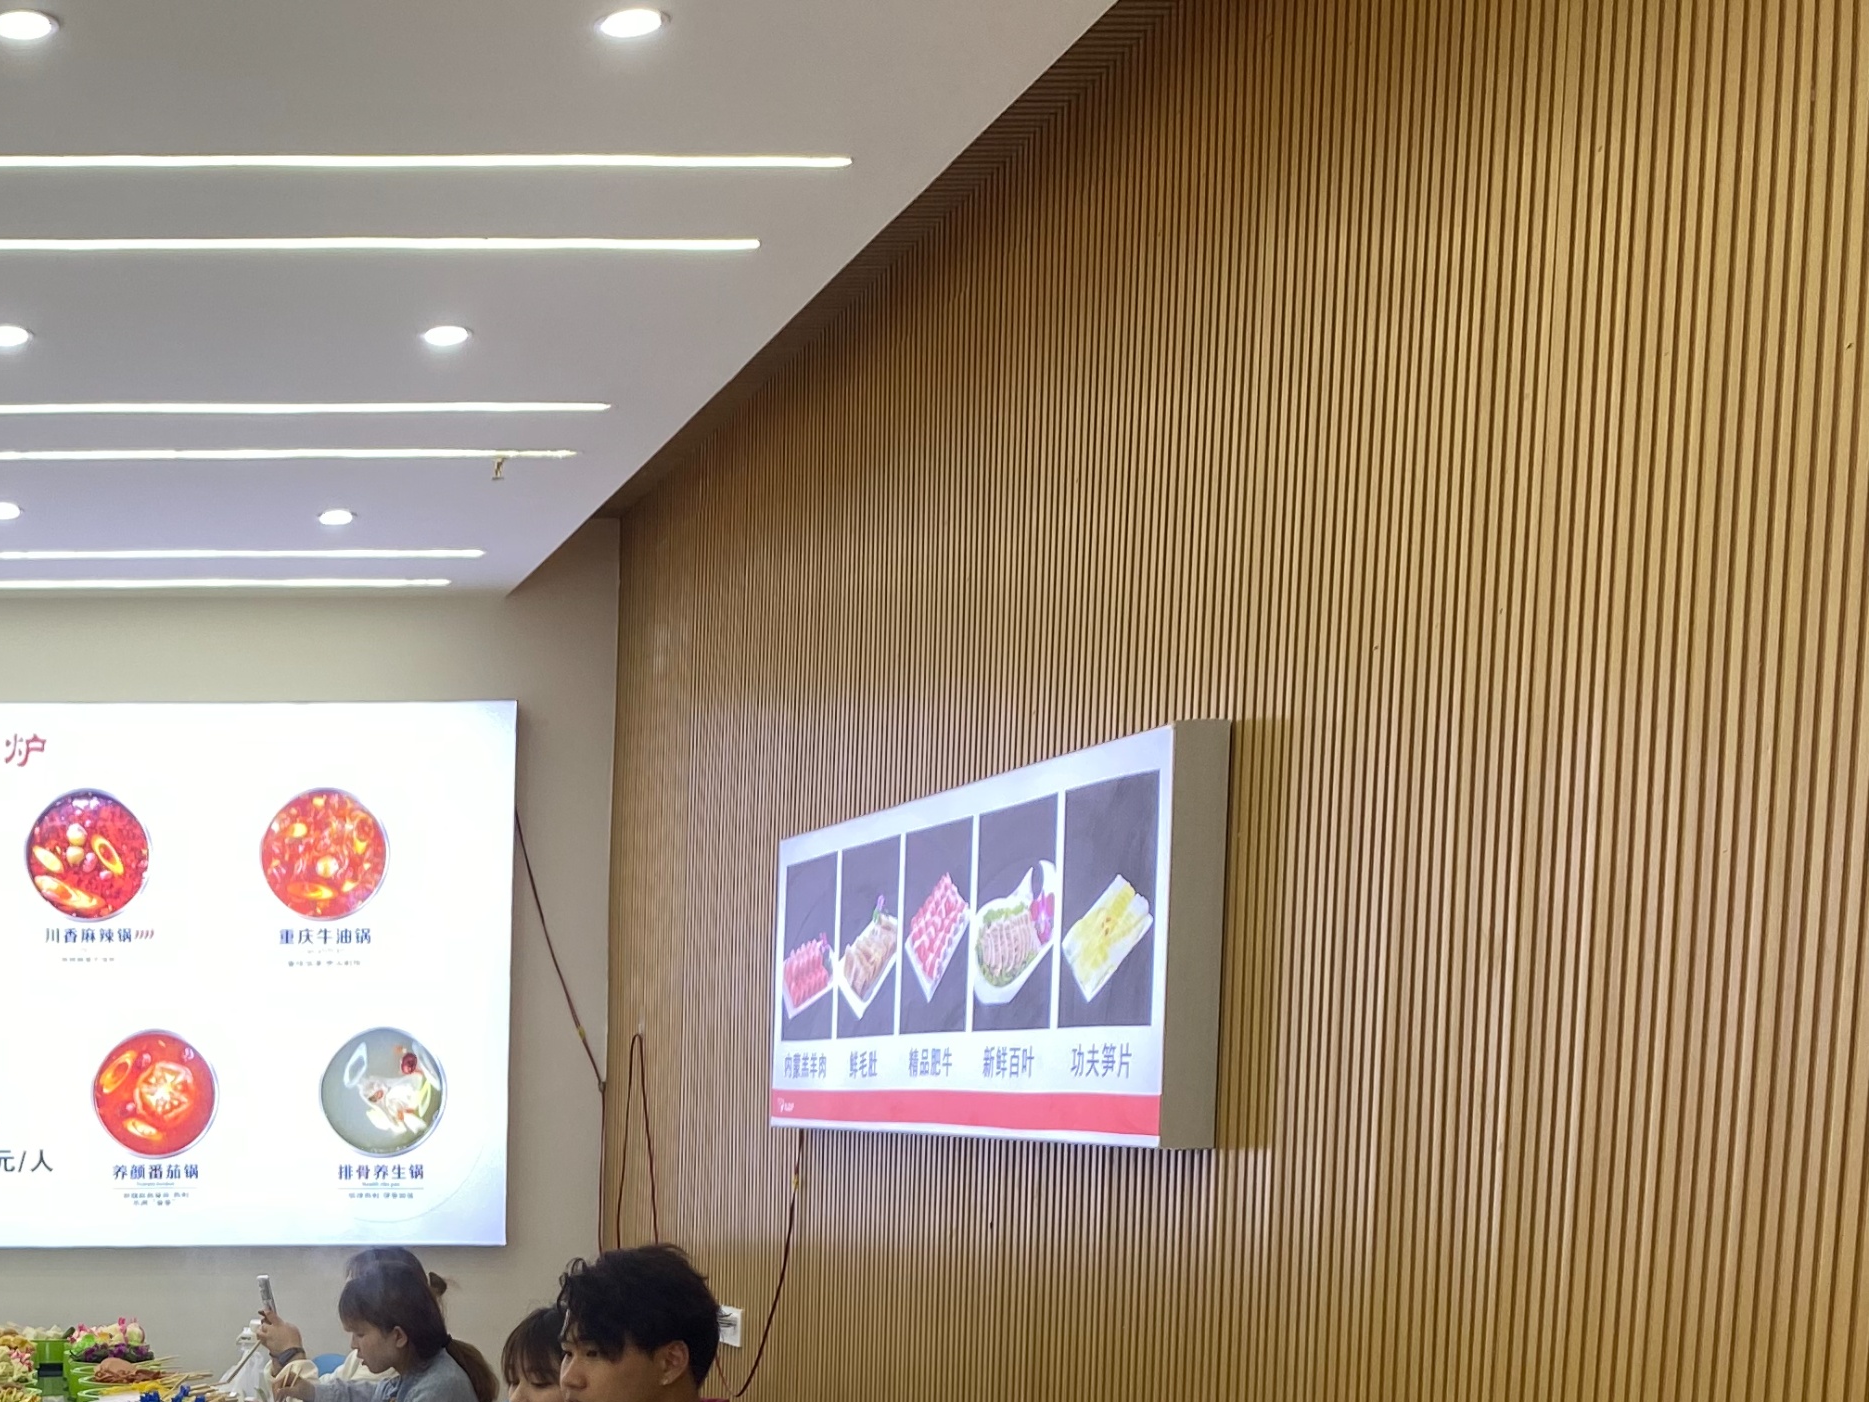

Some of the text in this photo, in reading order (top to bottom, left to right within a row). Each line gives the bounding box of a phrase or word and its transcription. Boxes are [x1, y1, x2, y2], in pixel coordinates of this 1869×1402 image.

[45, 928, 132, 943] 川香麻辣锅
[279, 928, 371, 945] 重庆牛油锅
[849, 1050, 878, 1078] 鲜毛肚
[908, 1047, 952, 1077] 精品肥牛
[983, 1045, 1035, 1078] 新鲜百叶
[1070, 1042, 1132, 1079] 功夫笋片
[338, 1164, 424, 1180] 排骨养生锅
